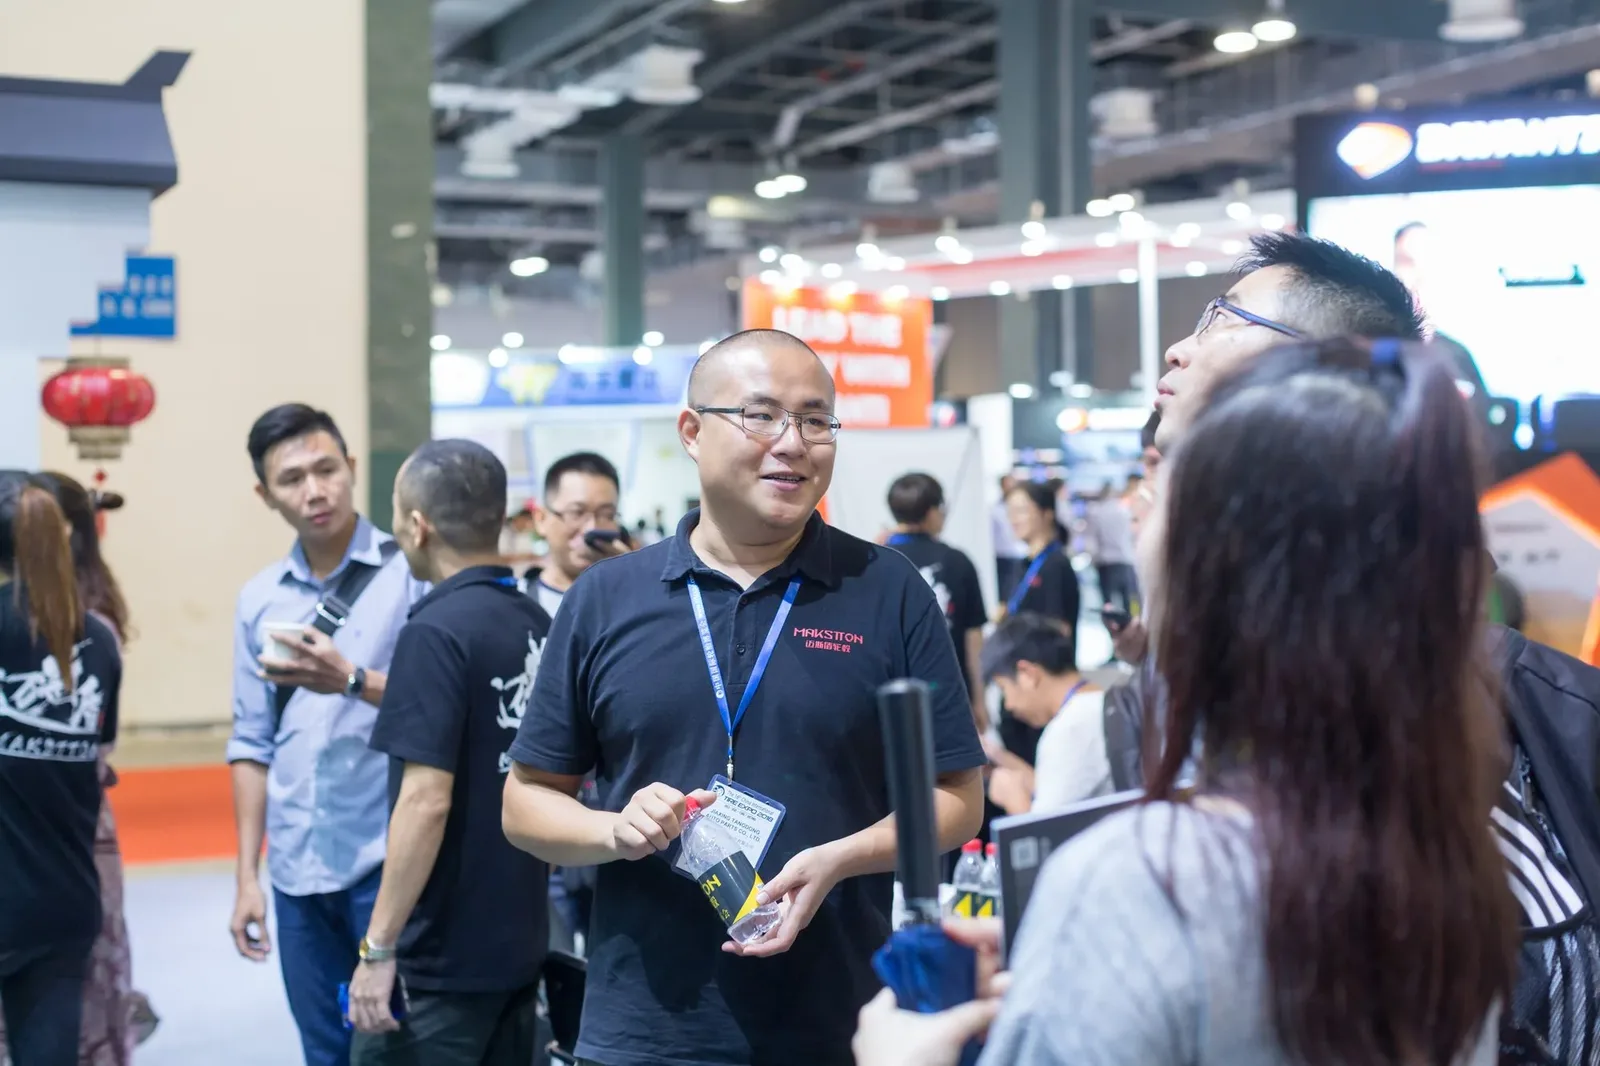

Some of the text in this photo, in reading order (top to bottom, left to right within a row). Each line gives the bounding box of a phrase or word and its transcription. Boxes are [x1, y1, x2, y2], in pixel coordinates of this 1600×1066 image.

[723, 795, 738, 806] TIRE
[737, 801, 757, 815] EXPO
[756, 810, 773, 823] 2018
